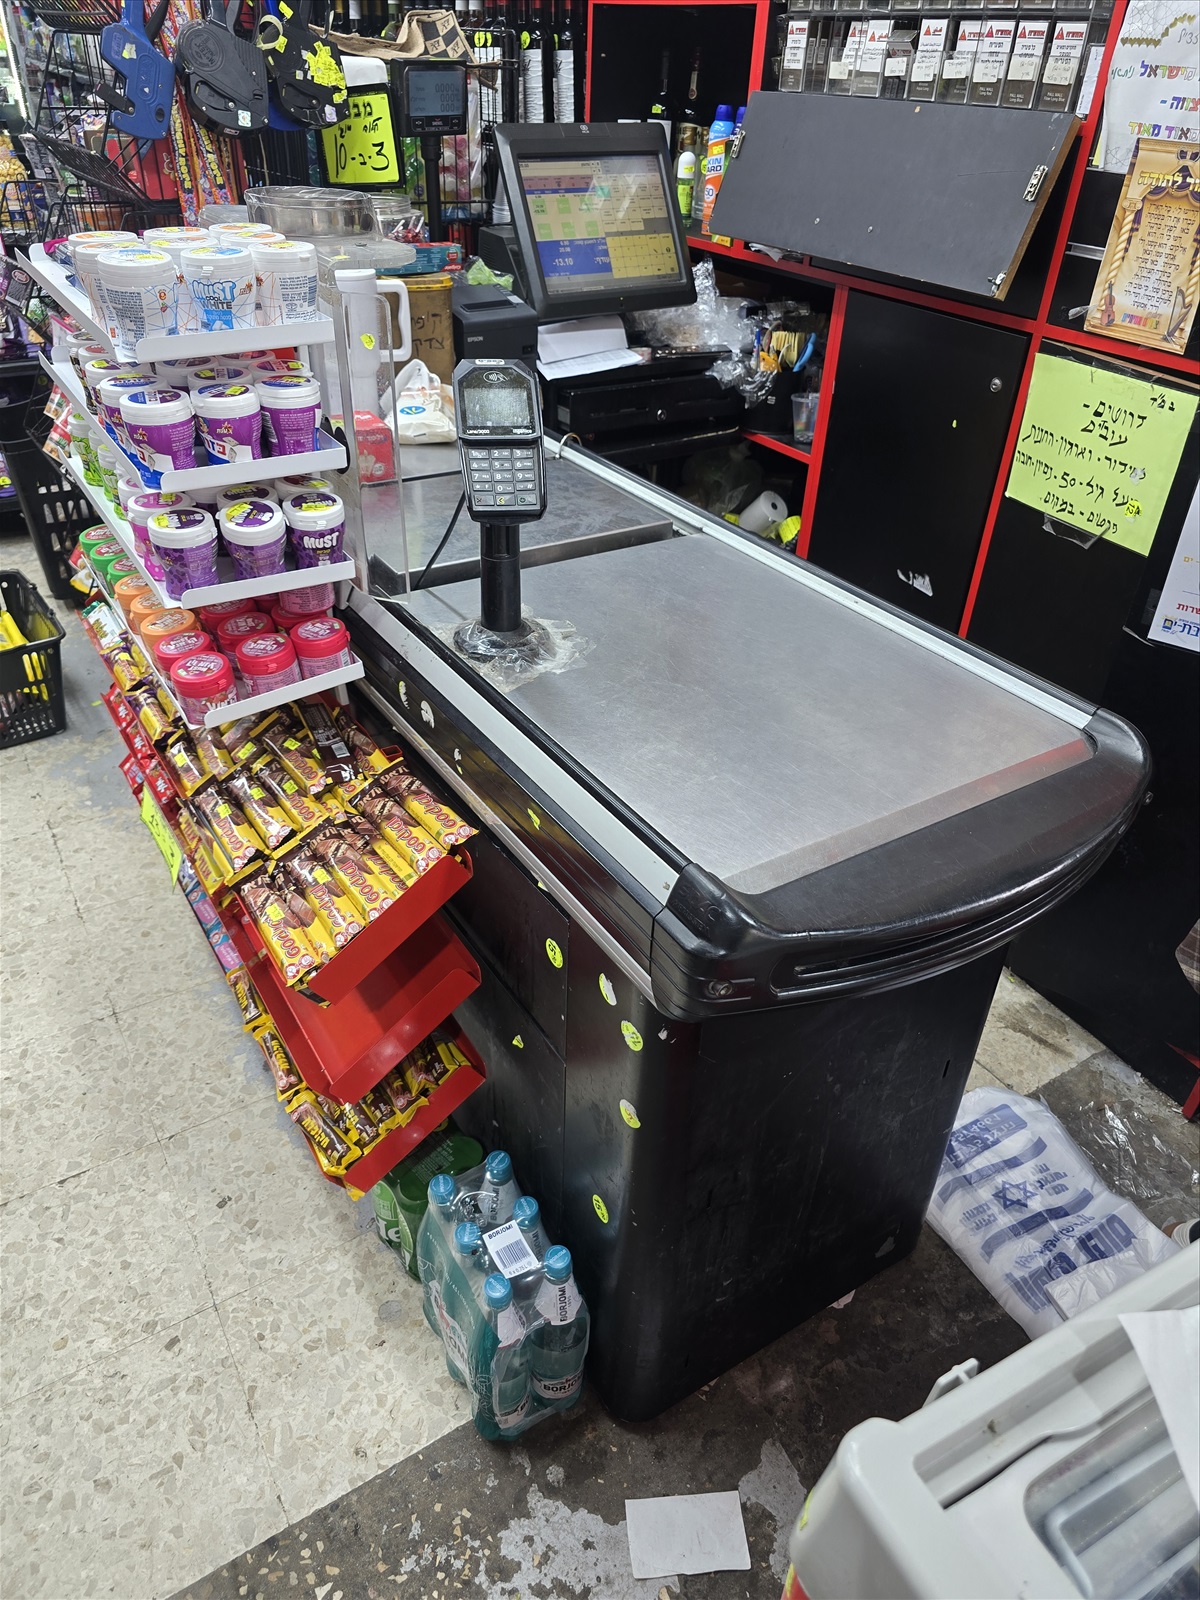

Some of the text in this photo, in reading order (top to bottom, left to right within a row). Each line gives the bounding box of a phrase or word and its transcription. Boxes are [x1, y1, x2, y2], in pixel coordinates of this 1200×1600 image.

[1128, 121, 1162, 137] מאוד
[553, 258, 574, 266] -13.10
[192, 280, 236, 302] MUST
[201, 301, 232, 310] WHITE
[1093, 400, 1147, 428] דרושים
[1059, 471, 1076, 488] 50
[304, 532, 339, 548] MUST
[490, 1187, 500, 1221] BORJOMI
[488, 1224, 514, 1240] BORJOMI
[560, 1286, 568, 1322] BORJOMI
